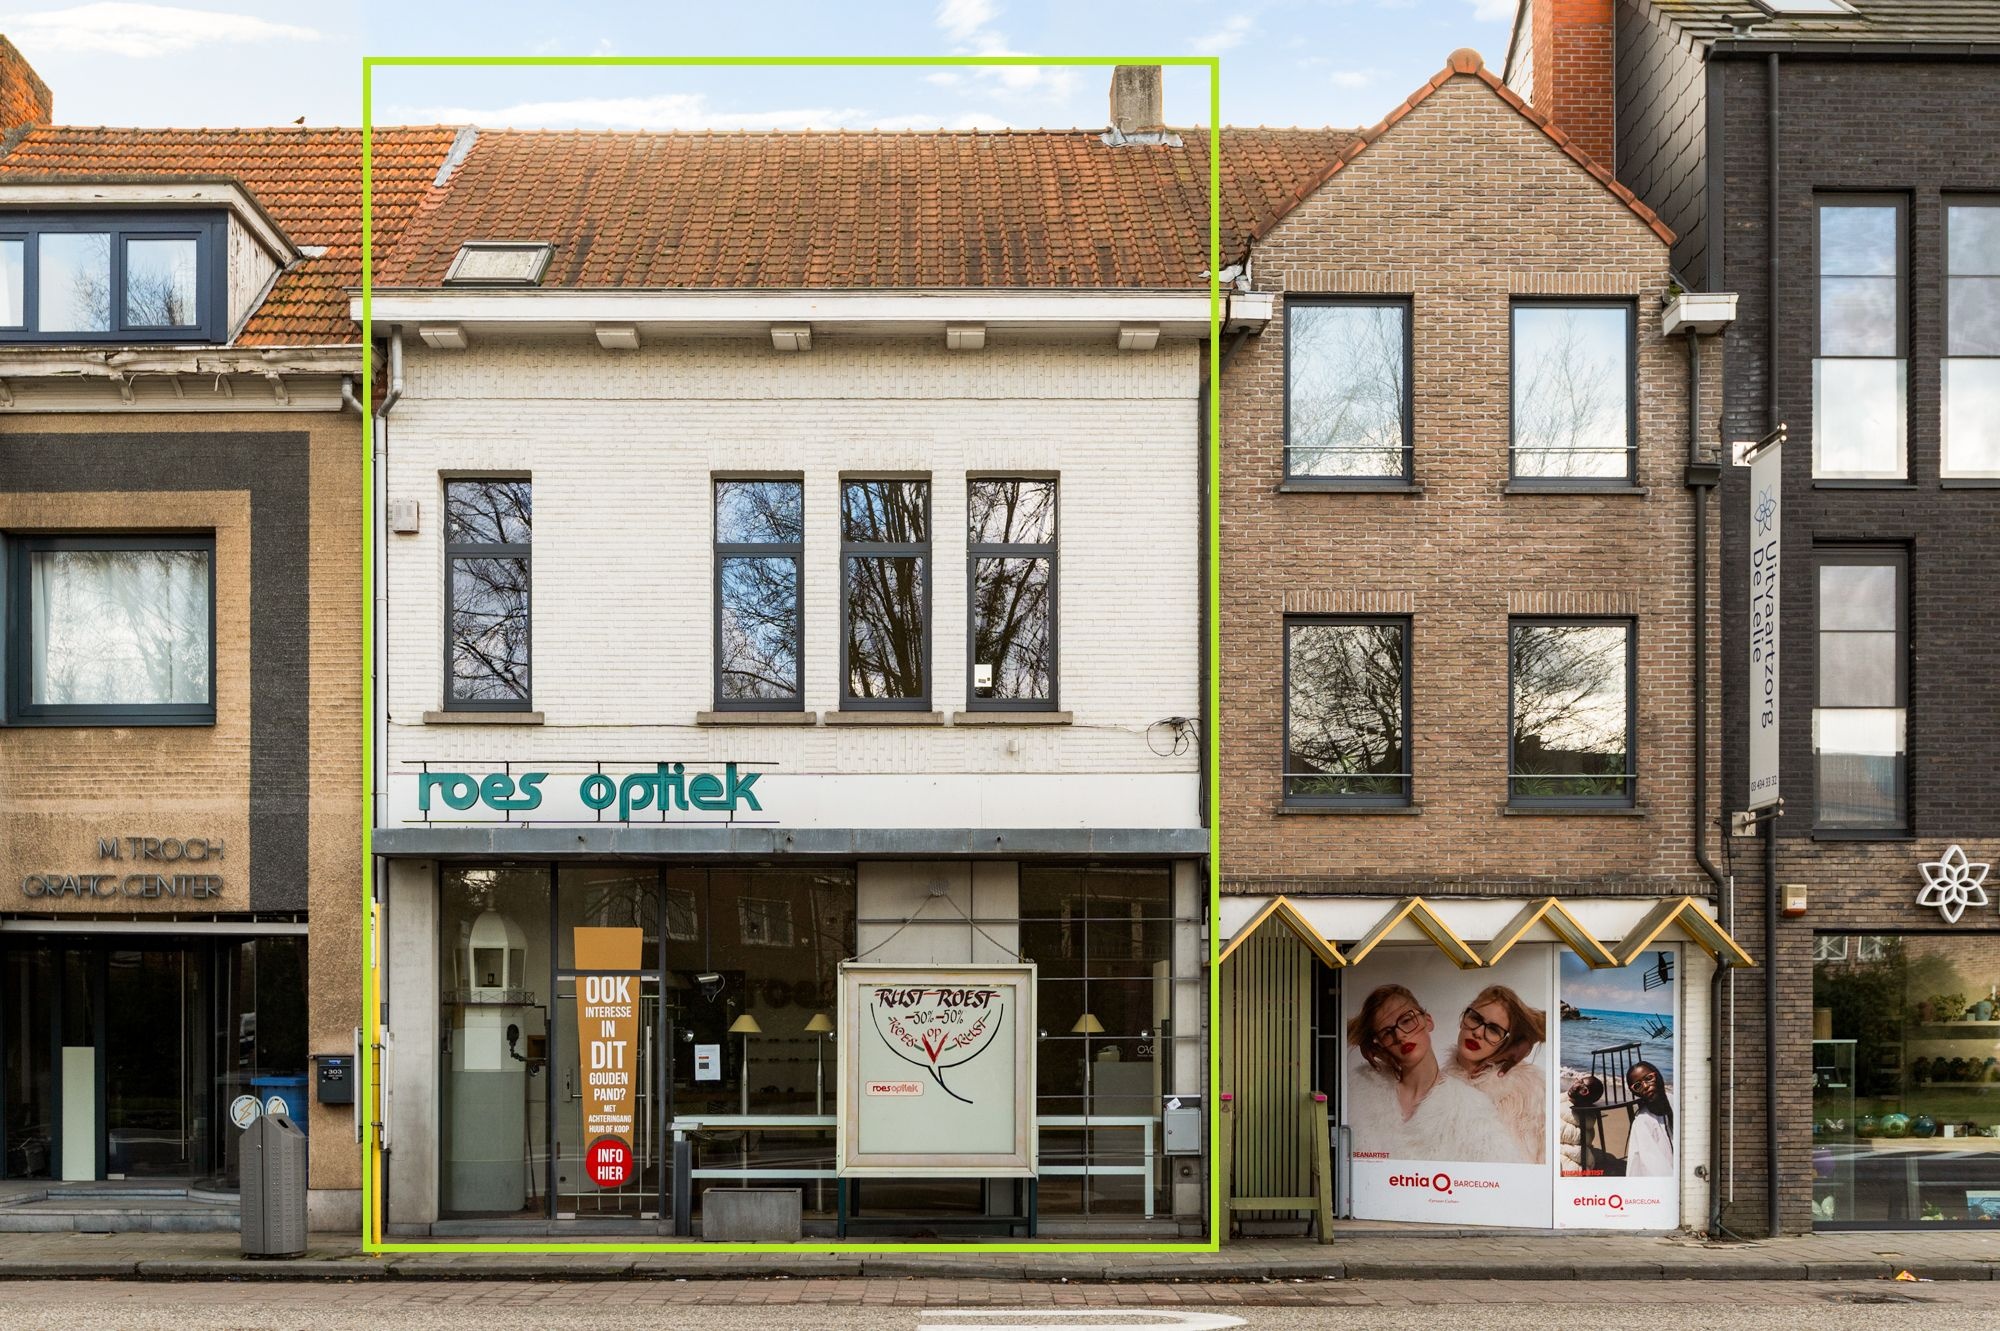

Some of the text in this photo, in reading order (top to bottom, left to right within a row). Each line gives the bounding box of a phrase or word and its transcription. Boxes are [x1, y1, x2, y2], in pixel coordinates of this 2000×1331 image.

[1753, 548, 1764, 663] De Lelie
[1761, 540, 1777, 728] Uitvaartzorg
[419, 762, 762, 821] roes optiek
[126, 836, 225, 861] TROCH
[122, 874, 224, 899] CENTER
[586, 976, 631, 1003] OOK
[876, 989, 997, 1009] RUST ROEST
[585, 1006, 632, 1018] INTERESSE
[601, 1020, 615, 1038] IN
[591, 1041, 627, 1069] DIT
[589, 1072, 628, 1085] GOUDEN
[594, 1088, 626, 1101] PAND?
[604, 1104, 616, 1112] MET
[588, 1115, 632, 1123] ACHTERINGANG
[589, 1125, 630, 1133] HUUR OF KOOP
[597, 1148, 623, 1163] INFO
[597, 1166, 623, 1180] HIER
[1389, 1173, 1500, 1188] etnia BARCELONA
[1573, 1195, 1606, 1206] etnia
